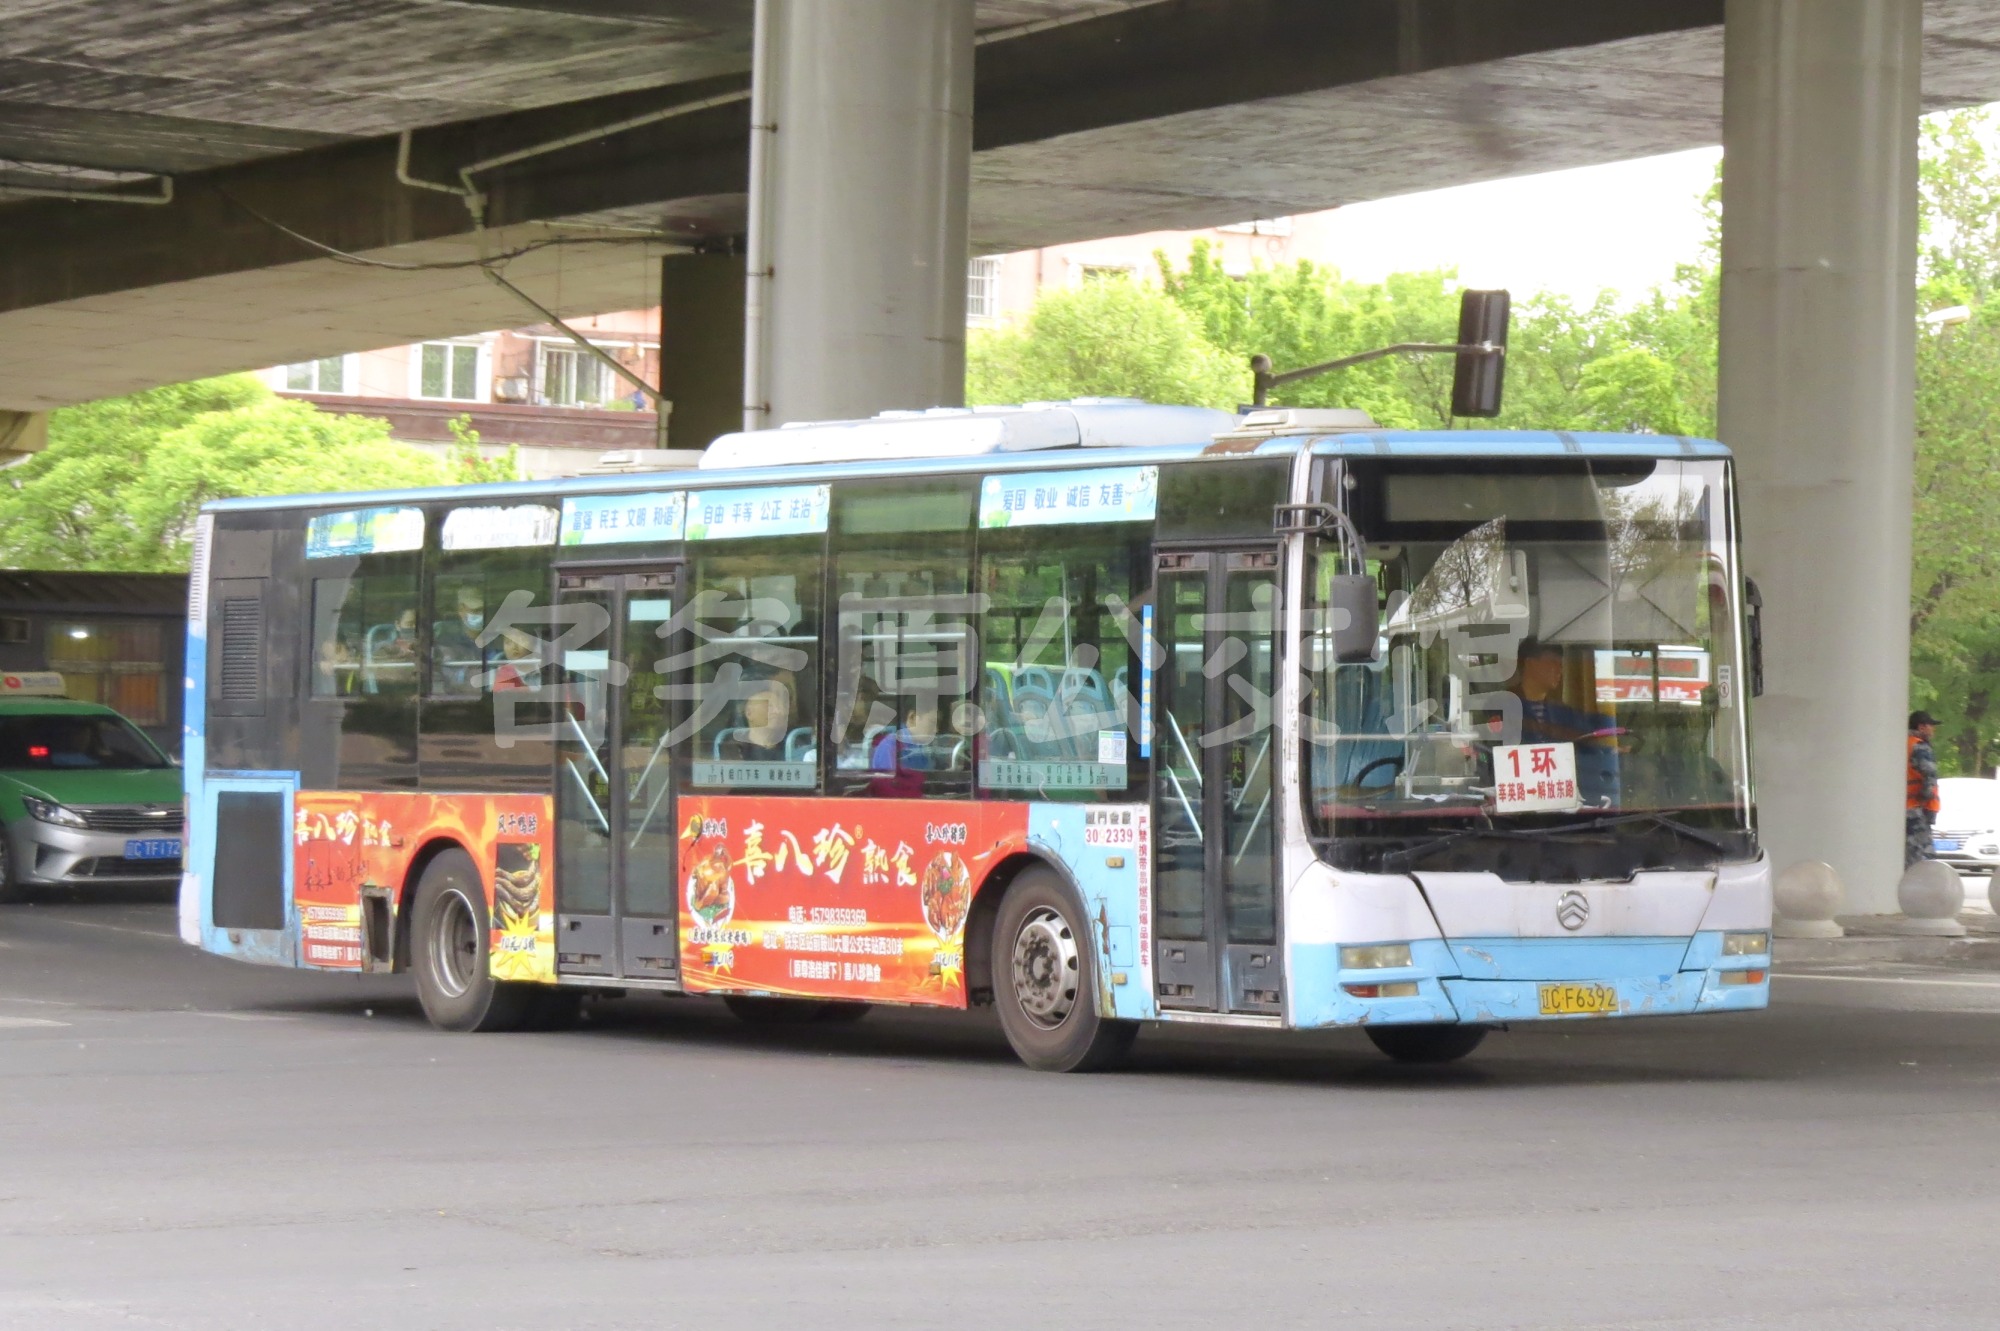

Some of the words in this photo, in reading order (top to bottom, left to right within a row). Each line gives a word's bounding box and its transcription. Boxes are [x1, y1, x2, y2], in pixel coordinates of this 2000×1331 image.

[1002, 488, 1026, 511] 爱国
[1034, 486, 1058, 510] 敬业
[1066, 485, 1091, 508] 诚信
[1099, 483, 1124, 506] 友善
[573, 509, 592, 531] 富强
[599, 509, 619, 529] 民主
[625, 507, 647, 527] 文明
[653, 505, 674, 526] 和谐
[703, 504, 725, 525] 自由
[732, 502, 754, 524] 平等
[760, 500, 782, 521] 公正
[789, 498, 811, 519] 法治
